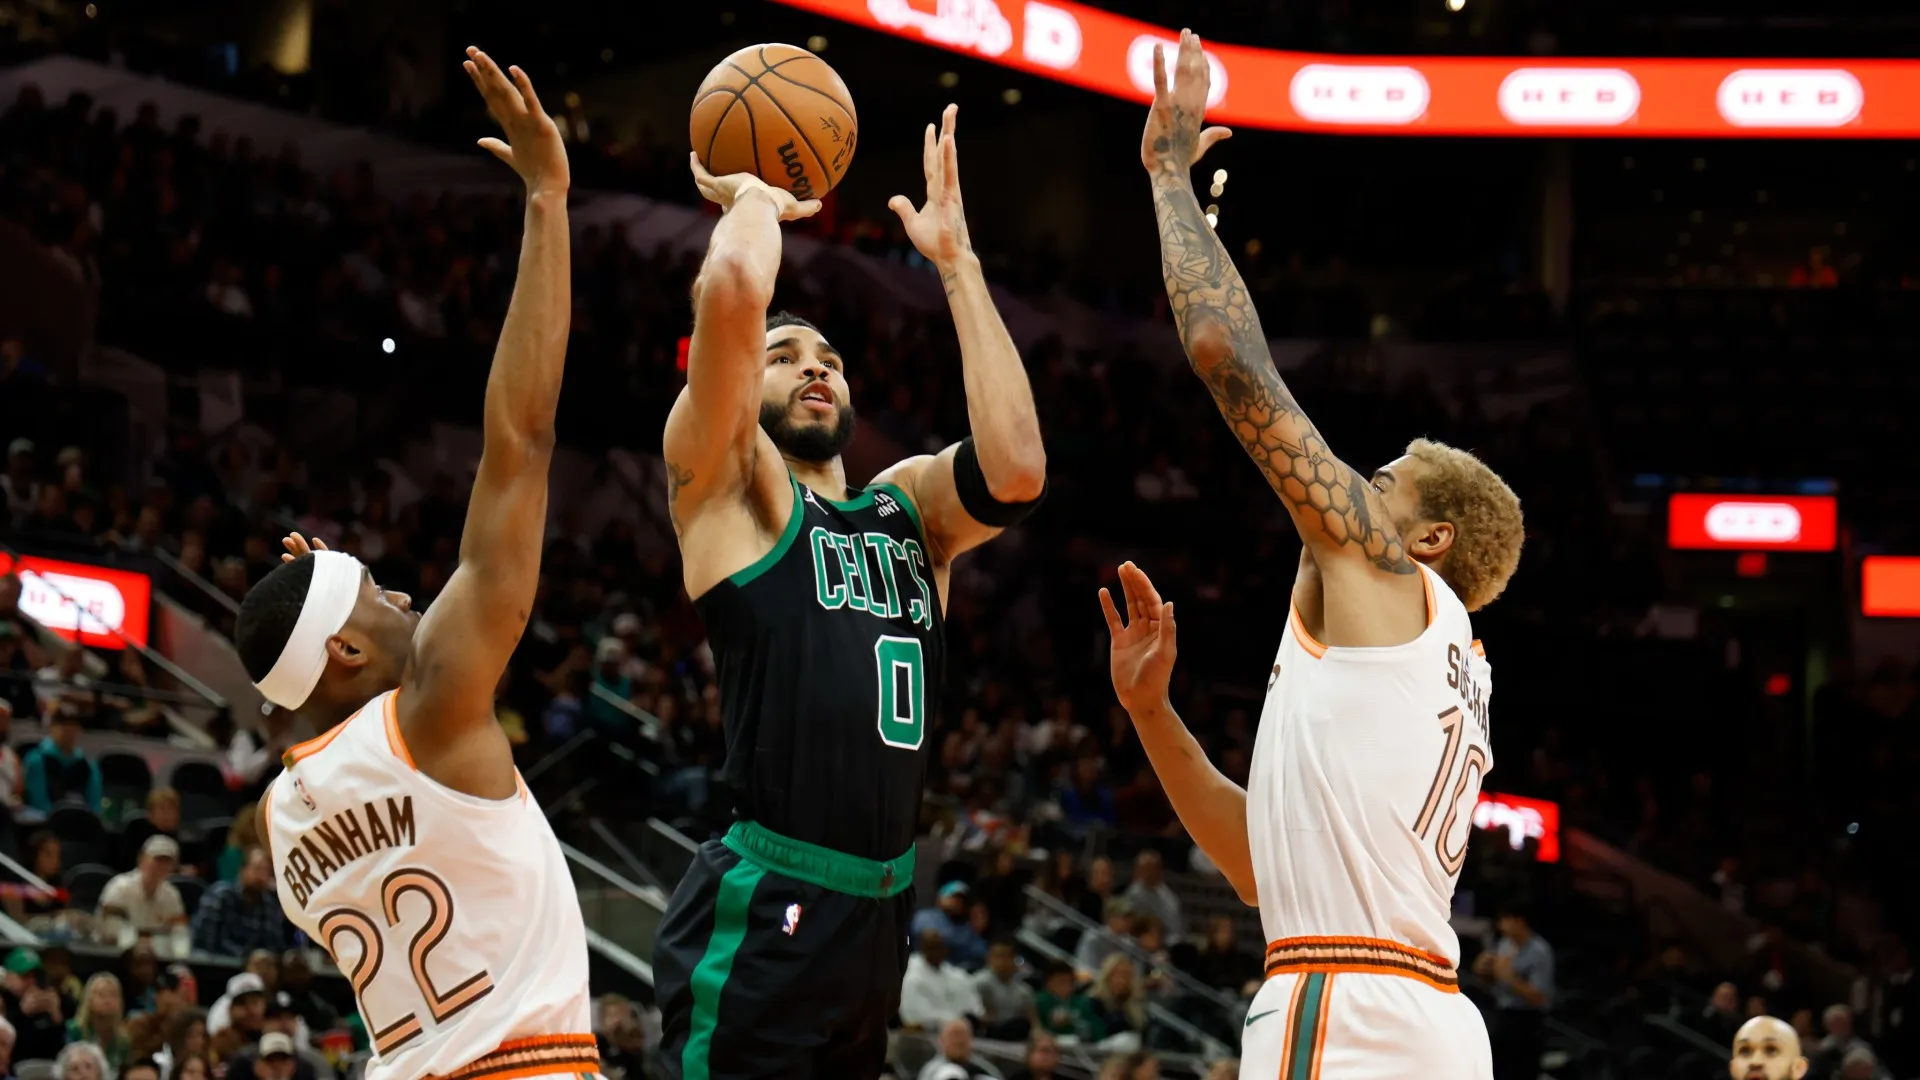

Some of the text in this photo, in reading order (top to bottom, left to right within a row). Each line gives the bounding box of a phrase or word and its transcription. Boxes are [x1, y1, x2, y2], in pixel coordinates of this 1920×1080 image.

[777, 140, 814, 201] lson
[810, 526, 932, 631] CELTS
[874, 634, 925, 751] 0
[1447, 642, 1491, 755] SOCHA
[1412, 704, 1487, 878] 10
[283, 795, 416, 911] BRANHAM
[317, 867, 495, 1057] 22
